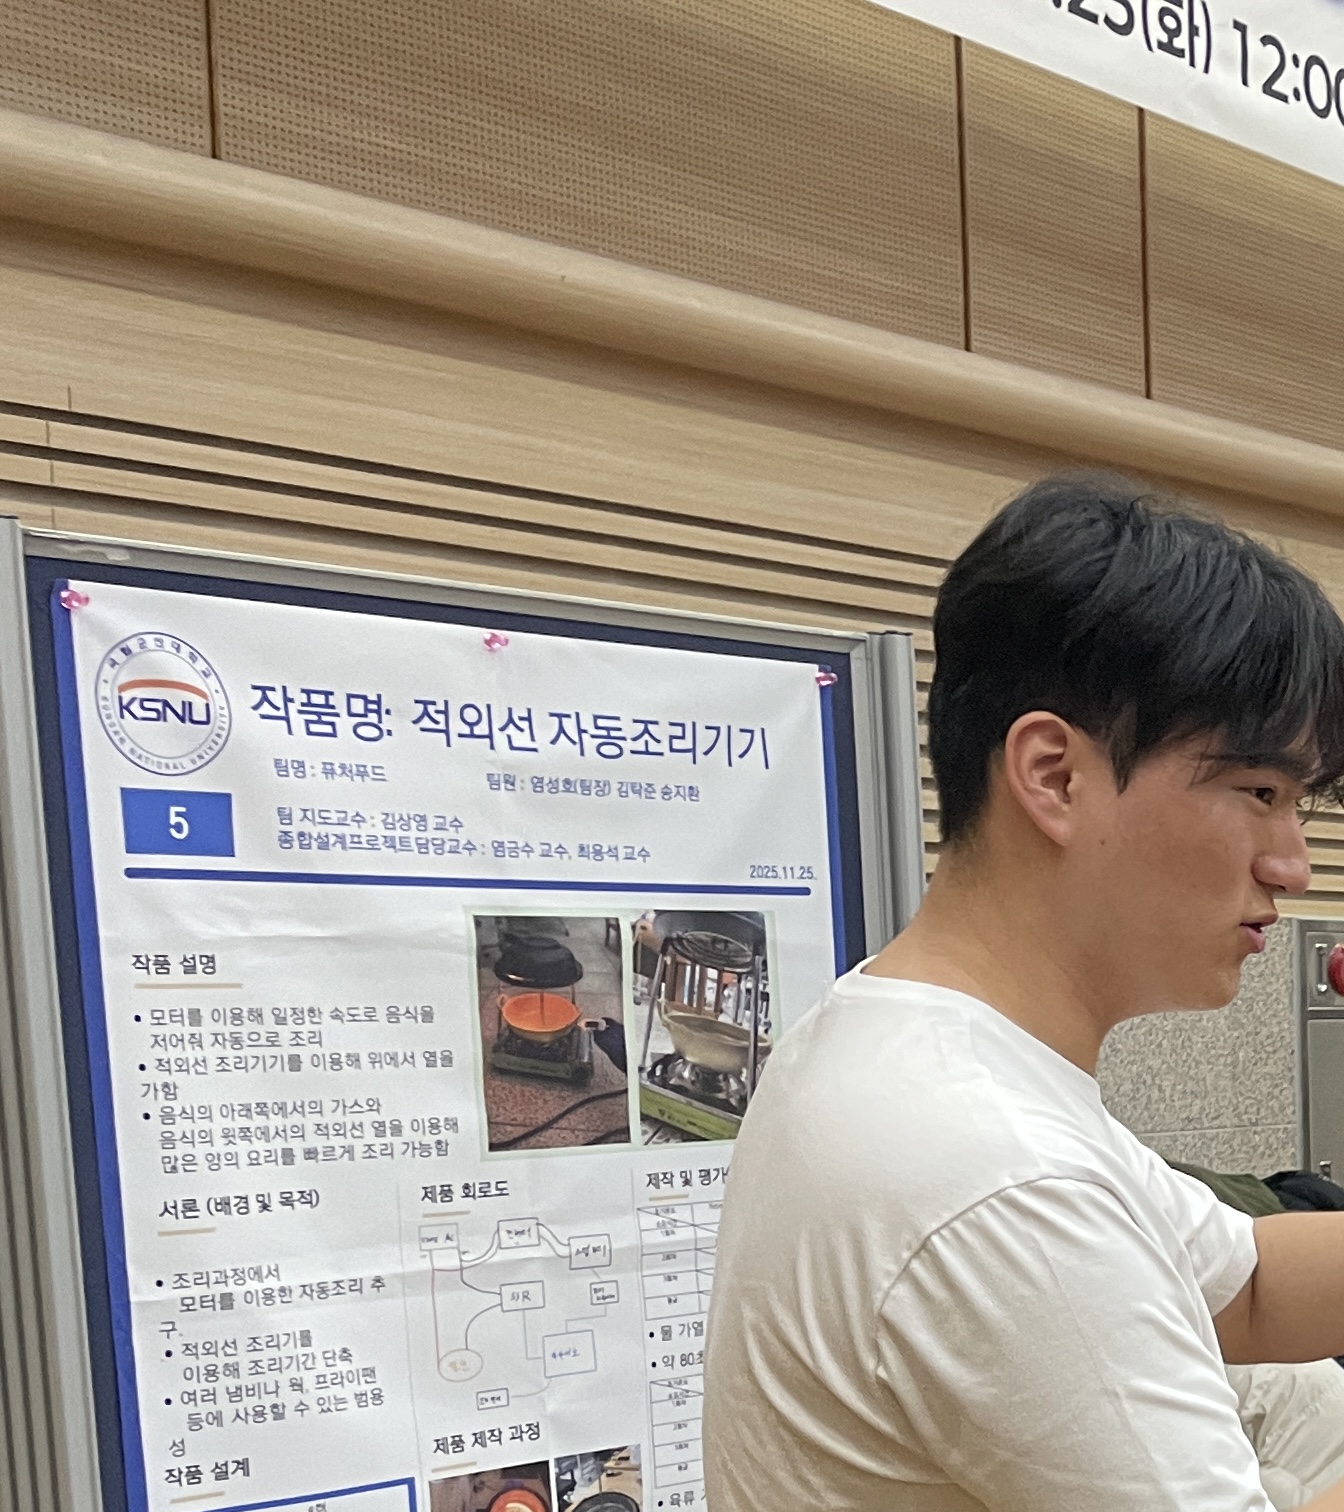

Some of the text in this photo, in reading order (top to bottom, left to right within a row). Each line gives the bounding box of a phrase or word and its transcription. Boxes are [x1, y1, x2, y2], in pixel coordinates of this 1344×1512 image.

[117, 694, 211, 726] KSNU
[250, 683, 771, 771] 작품명: 적외선 자동조리기기
[273, 758, 388, 782] 팀명 퓨처푸드
[486, 773, 517, 792] 팀원
[168, 807, 190, 840] 5
[277, 807, 464, 833] 팀 지도교수 김상영 교수
[491, 840, 535, 859] 염금수
[623, 846, 651, 863] 교수
[750, 864, 817, 881] 2025.11.25.
[131, 954, 217, 975] 작품 설명
[150, 1005, 434, 1027] 모터를 이용해 일정한 속도로 음식을
[211, 1031, 282, 1049] 자동으로
[289, 1031, 322, 1048] 조리
[155, 1050, 453, 1075] 적외선 조리기기를 이용해 위에서 열을
[140, 1082, 178, 1100] 가함
[159, 1098, 381, 1125] 음식의 아래쪽에서의 가스와
[159, 1116, 459, 1149] 음식의 윗쪽에서의 적외선 열을 이용해
[161, 1139, 449, 1173] 많은 양의 요리를 빠르게 조리 가능함
[421, 1180, 510, 1204] 제품 회로도
[646, 1171, 673, 1189] 제작
[679, 1170, 693, 1187] 및
[159, 1189, 319, 1220] 서론 (배경 및 목적)
[172, 1264, 281, 1290] 조리과정에서
[179, 1276, 386, 1312] 모터를 이용한 자동조리 추
[660, 1320, 704, 1341] 물 가열
[182, 1329, 312, 1359] 적외선 조리기를
[183, 1347, 353, 1383] 이용해 조리기간 단축
[662, 1354, 675, 1370] 약
[180, 1387, 217, 1407] 여러
[226, 1380, 280, 1403] 냄비나
[315, 1366, 377, 1391] 프라이팬
[186, 1387, 384, 1432] 등에 사용할 수 있는 범용
[169, 1438, 186, 1458] 성
[433, 1422, 541, 1455] 제품 제작 과정
[164, 1458, 250, 1487] 작품 설계
